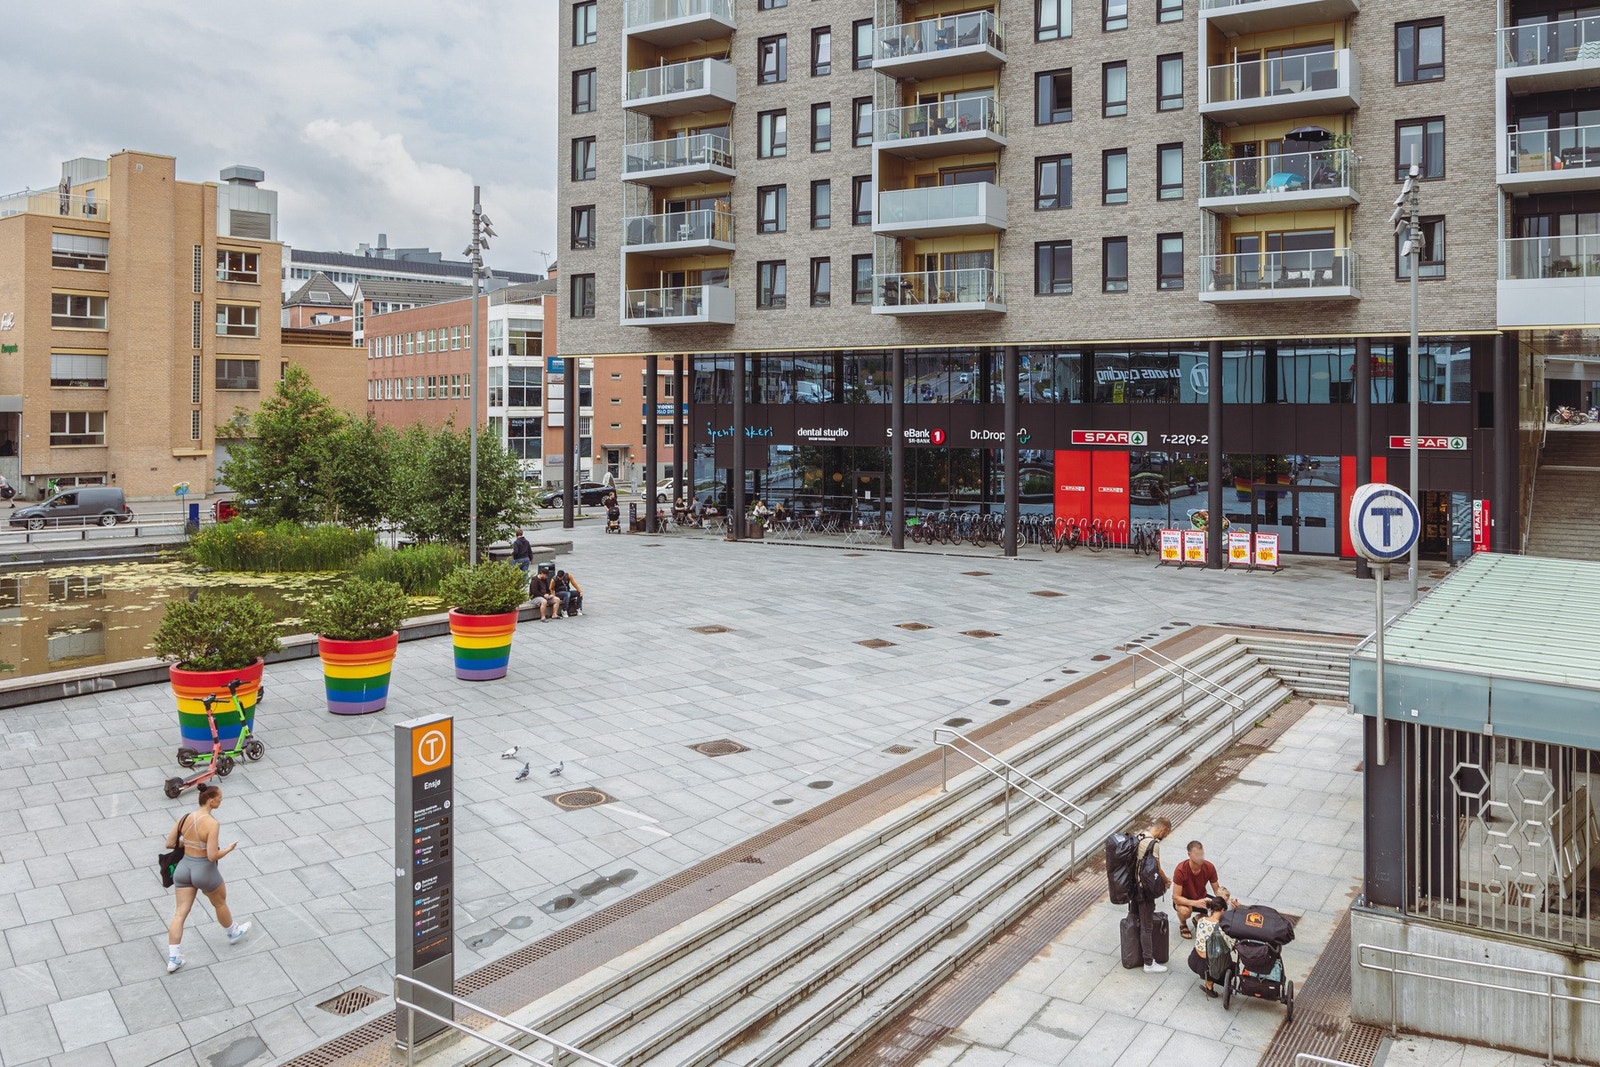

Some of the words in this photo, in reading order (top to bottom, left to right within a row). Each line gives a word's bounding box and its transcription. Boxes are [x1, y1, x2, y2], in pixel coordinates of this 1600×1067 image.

[744, 426, 774, 439] akeri
[797, 427, 822, 437] dental
[823, 428, 849, 437] studio
[886, 428, 930, 438] SeBank
[970, 429, 1005, 442] Dr.Drop
[1085, 433, 1129, 443] SPAR
[1403, 438, 1448, 448] SPAR
[1371, 508, 1403, 547] T
[426, 737, 438, 761] T
